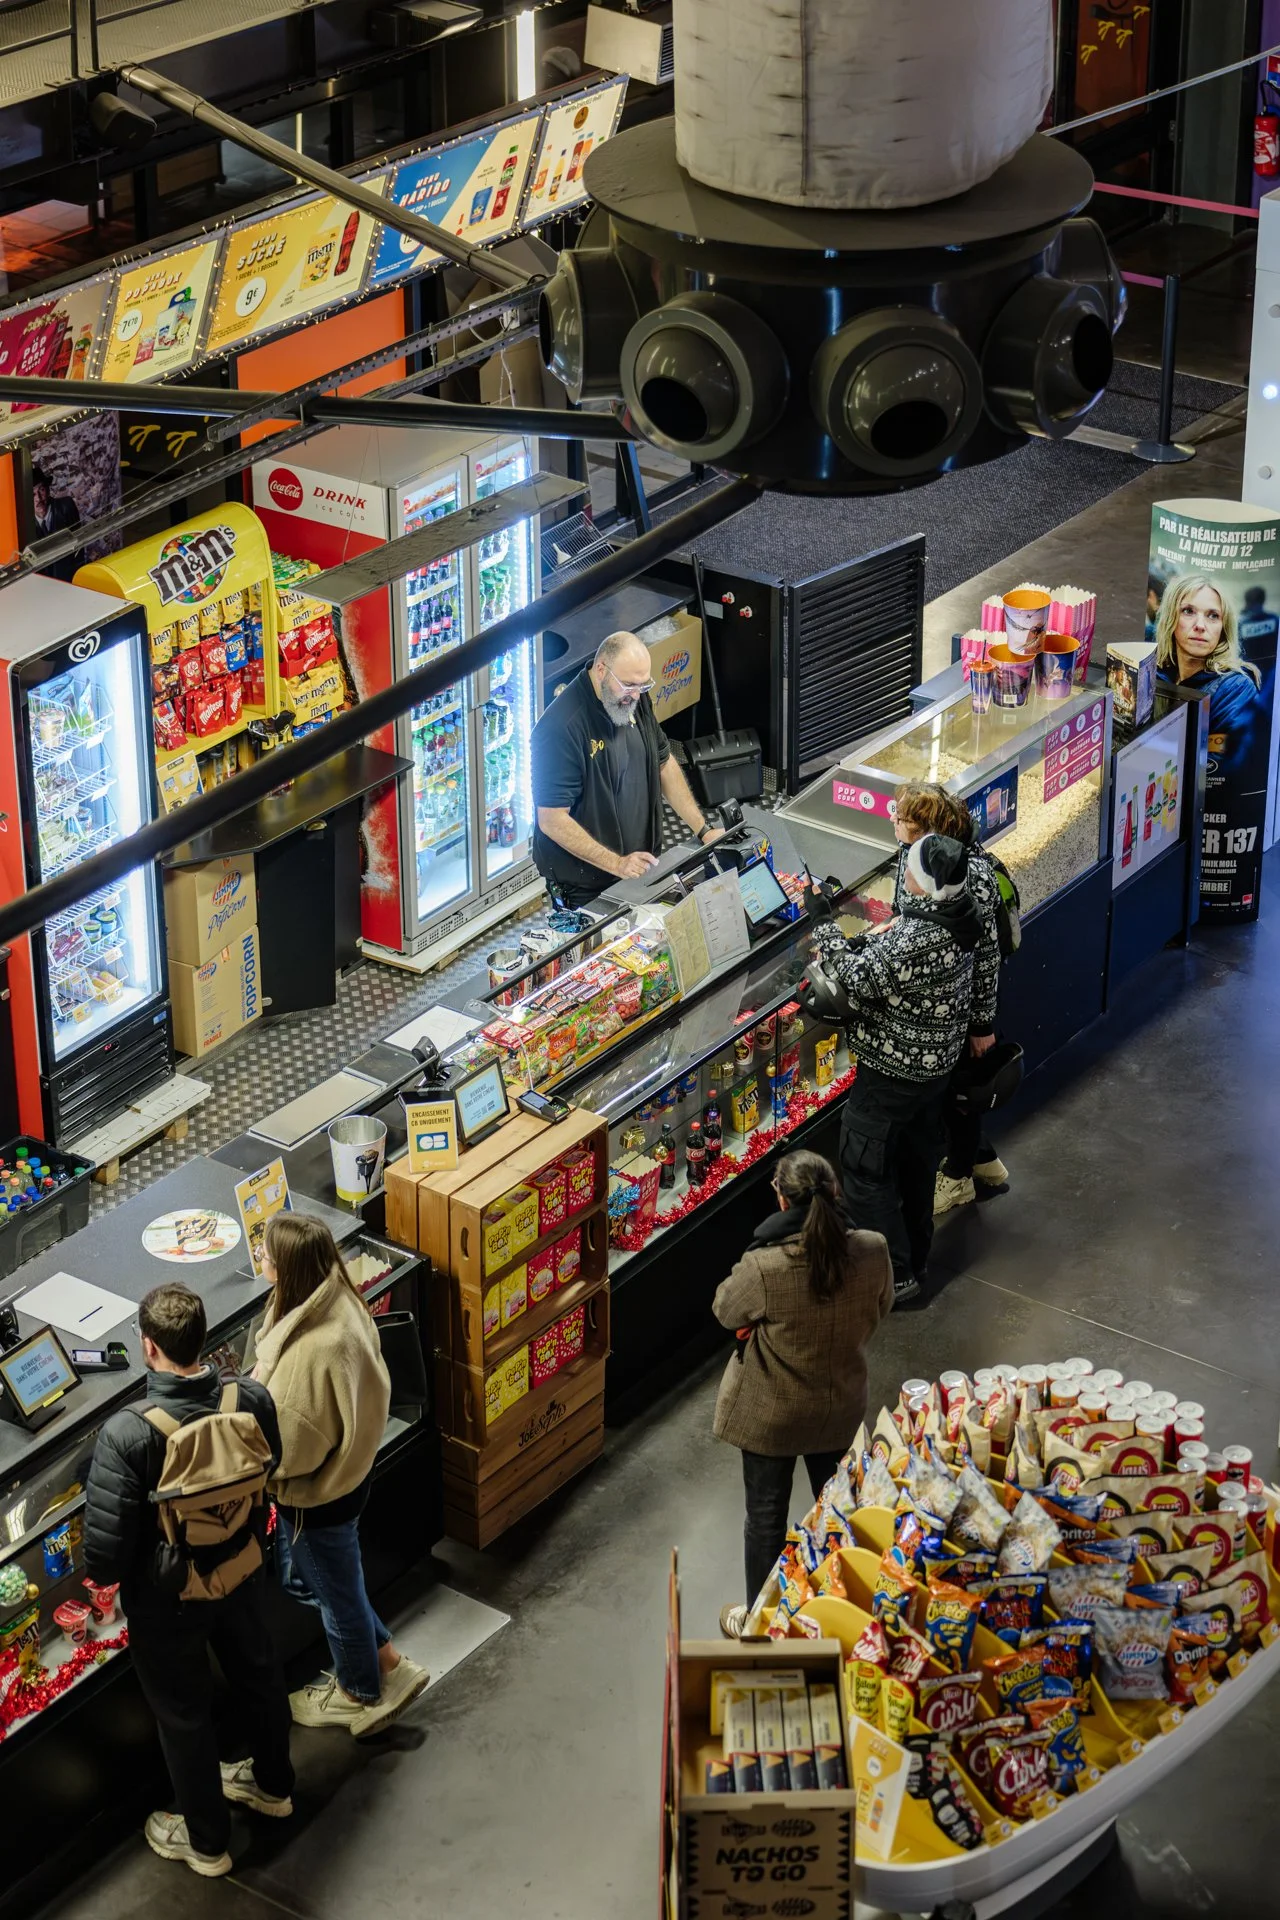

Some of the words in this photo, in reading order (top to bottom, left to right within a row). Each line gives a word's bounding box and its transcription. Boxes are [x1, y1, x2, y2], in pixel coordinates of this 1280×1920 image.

[416, 172, 440, 189] MENU
[399, 178, 451, 208] HARIBO
[252, 233, 278, 251] MENU
[236, 235, 286, 271] SUCRÉ
[245, 287, 259, 306] 9€
[23, 335, 47, 360] POP
[21, 347, 46, 370] CORN
[269, 480, 301, 499] Coca-Cola
[313, 486, 367, 510] DRINK
[315, 503, 333, 513] ICE
[339, 510, 365, 521] COLD
[1160, 516, 1177, 535] PAR
[1178, 523, 1189, 538] LE
[1190, 526, 1262, 544] RÉALISATEUR
[1263, 528, 1277, 542] DE
[1179, 538, 1192, 552] LA
[1193, 542, 1221, 557] NUIT
[1221, 545, 1239, 558] DU
[1240, 545, 1254, 557] 12
[150, 525, 236, 605] m&m's
[1157, 546, 1186, 563] HALETANT
[1191, 556, 1227, 569] PUISSANT
[1232, 558, 1275, 570] IMPLACABLE
[837, 794, 856, 803] CORN
[838, 786, 856, 797] POP
[1203, 813, 1227, 824] CKER
[1223, 827, 1258, 854] 137
[1200, 882, 1229, 892] EMBRE
[242, 934, 257, 1019] POPCORN
[203, 1030, 222, 1048] FRAGILE
[411, 1119, 419, 1127] CB
[420, 1117, 452, 1126] UNIQUEMENT
[412, 1108, 450, 1119] ENCAISSEMENT
[574, 1177, 590, 1193] BOX
[546, 1195, 563, 1212] BOX
[518, 1216, 535, 1233] BOX
[491, 1237, 510, 1254] BOX
[565, 1329, 580, 1344] BOX
[539, 1348, 555, 1365] BOX
[508, 1370, 525, 1387] BOX
[1058, 1527, 1096, 1541] oritos
[926, 1601, 969, 1623] Cheetos
[926, 1689, 978, 1733] Curly
[715, 1845, 820, 1865] NACHOS
[730, 1866, 765, 1883] TO
[770, 1864, 807, 1882] GO
